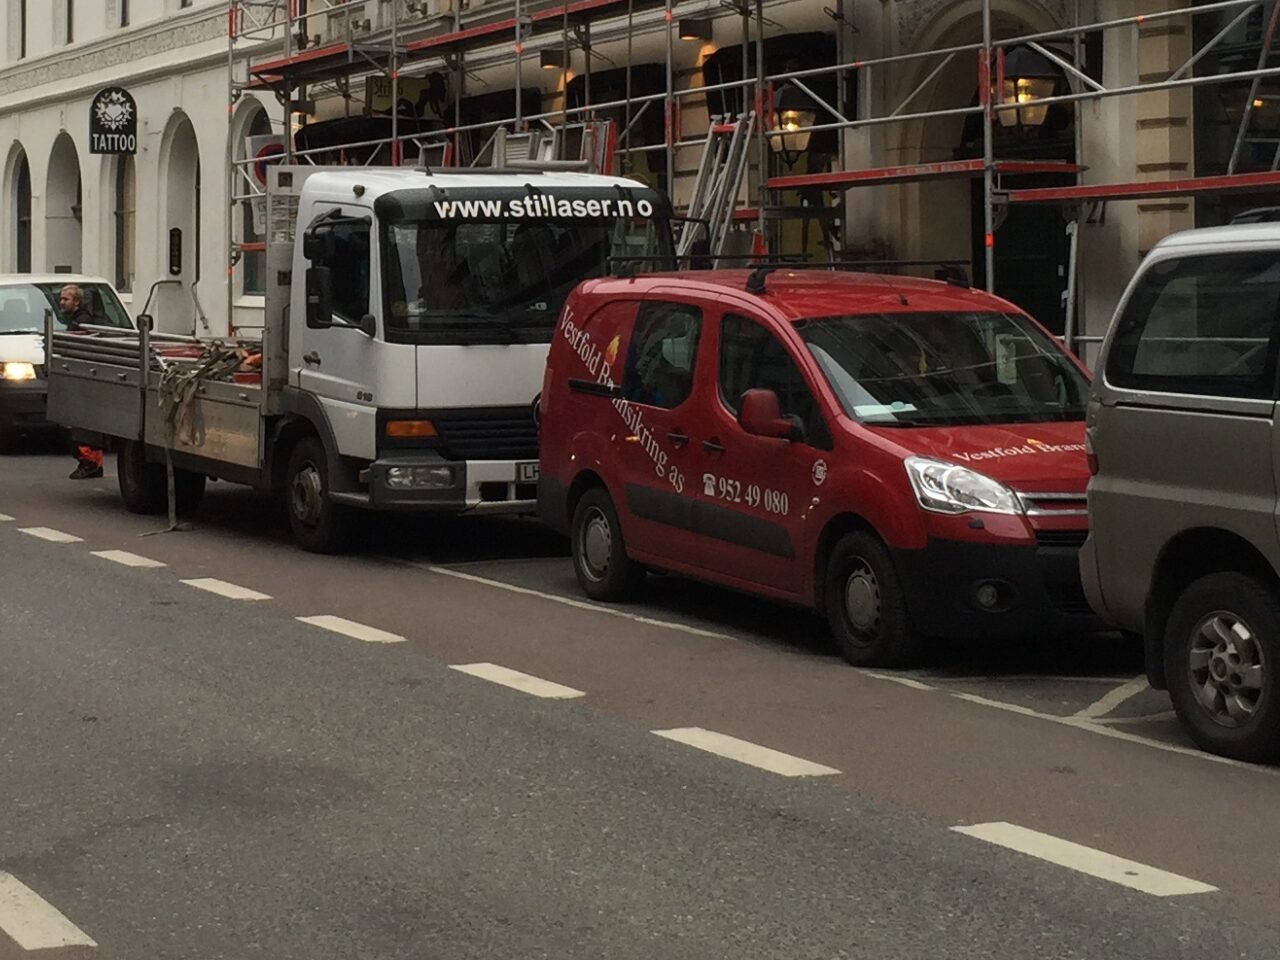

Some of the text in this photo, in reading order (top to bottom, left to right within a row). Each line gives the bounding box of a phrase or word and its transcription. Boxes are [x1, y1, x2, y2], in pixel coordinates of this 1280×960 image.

[92, 133, 135, 152] TATTOO
[434, 194, 653, 219] www.stillaser.no
[559, 305, 603, 376] Vestfold
[669, 465, 686, 494] as
[952, 445, 1036, 462] Vestfold
[719, 477, 789, 516] 952 49 080
